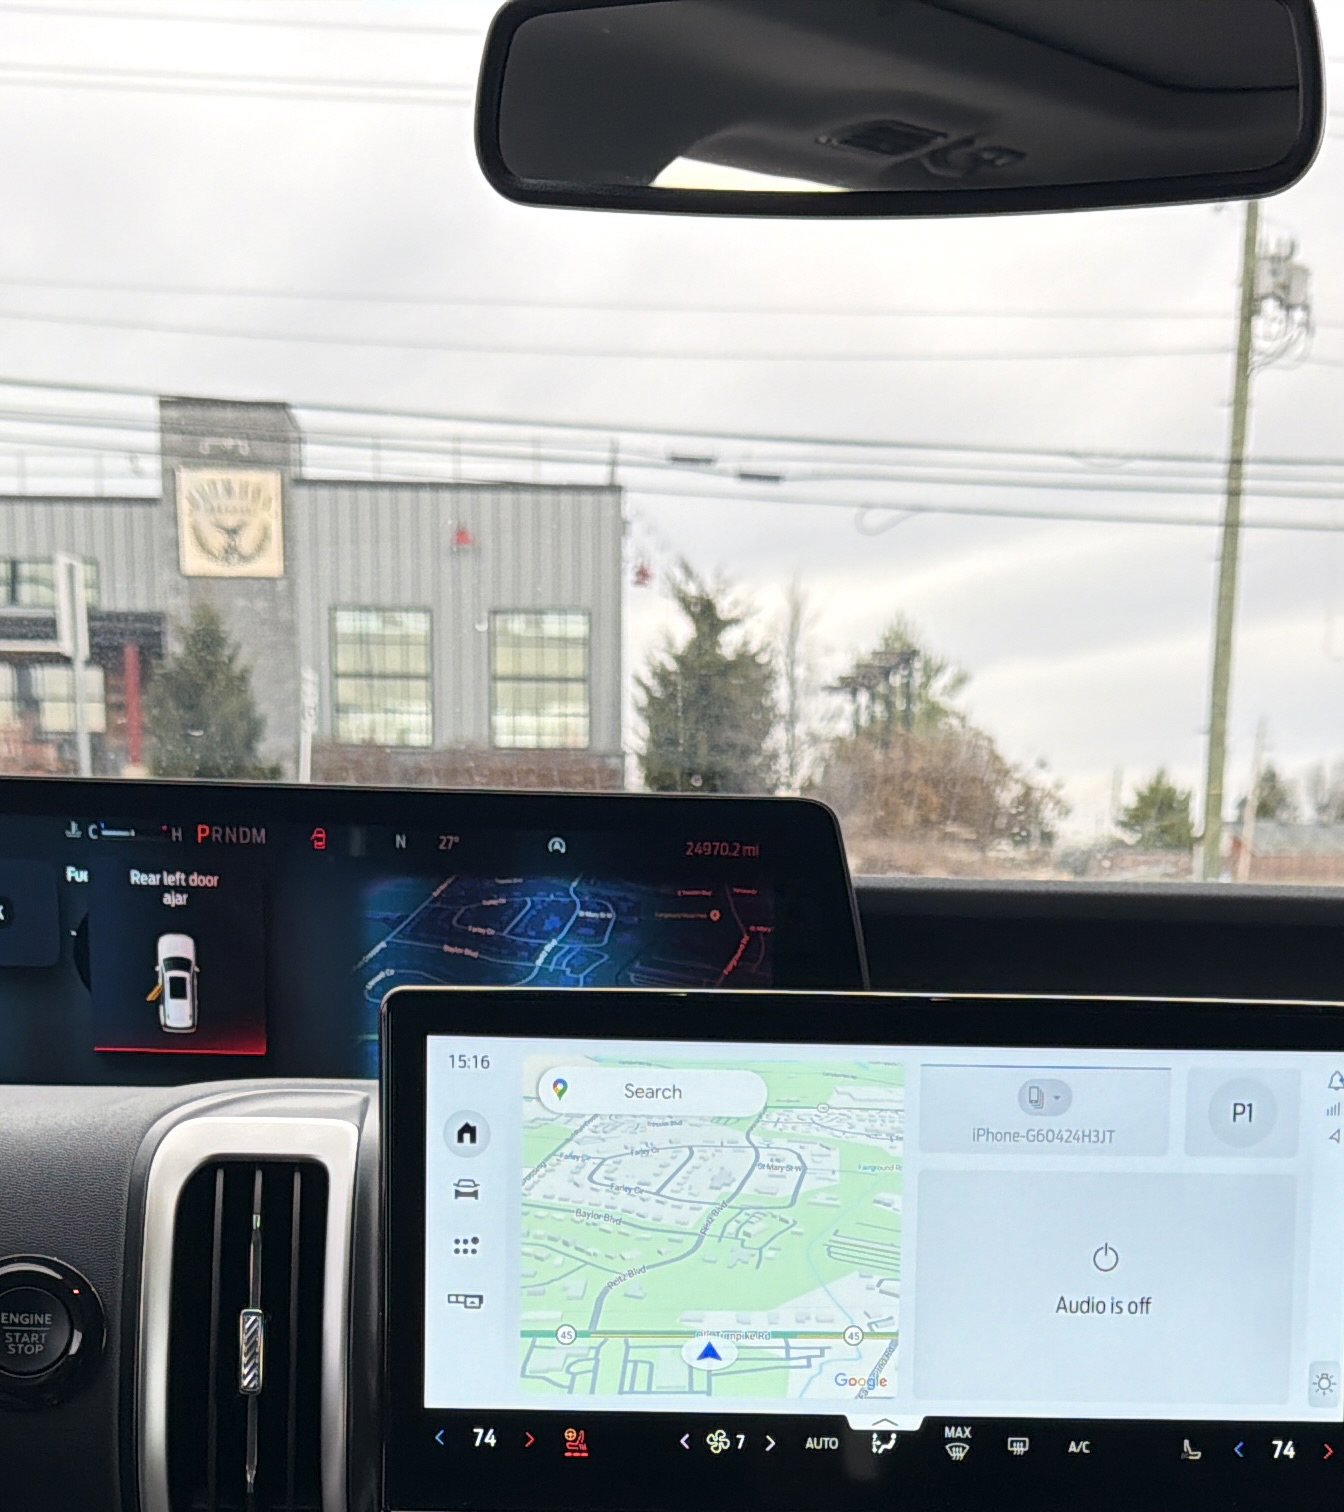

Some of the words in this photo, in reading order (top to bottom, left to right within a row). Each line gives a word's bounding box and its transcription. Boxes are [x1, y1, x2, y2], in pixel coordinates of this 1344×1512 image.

[170, 826, 183, 843] H
[395, 833, 407, 849] N
[685, 841, 741, 858] 24970.2
[741, 842, 760, 857] mi
[128, 868, 161, 886] Rear
[162, 870, 187, 887] left
[188, 871, 220, 888] door
[162, 891, 189, 908] ajar
[447, 1053, 491, 1072] 15:16
[623, 1082, 683, 1101] Search
[1231, 1101, 1255, 1124] P1
[575, 1207, 602, 1221] Baylor
[603, 1212, 624, 1227] Blvd
[627, 1264, 648, 1279] Blvd
[1055, 1295, 1108, 1316] Audio
[1109, 1295, 1124, 1316] is
[1126, 1294, 1153, 1316] off
[0, 1312, 53, 1325] ENGINE
[4, 1331, 48, 1344] START
[559, 1328, 574, 1343] 45
[758, 1330, 772, 1341] Rd
[846, 1330, 861, 1342] 45
[7, 1343, 45, 1356] STOP
[834, 1371, 889, 1391] Google
[471, 1428, 498, 1449] 74
[944, 1425, 973, 1440] MAX
[736, 1434, 747, 1450] 7
[804, 1436, 840, 1452] AUTO
[1067, 1439, 1092, 1456] A/C
[1270, 1440, 1297, 1461] 74
